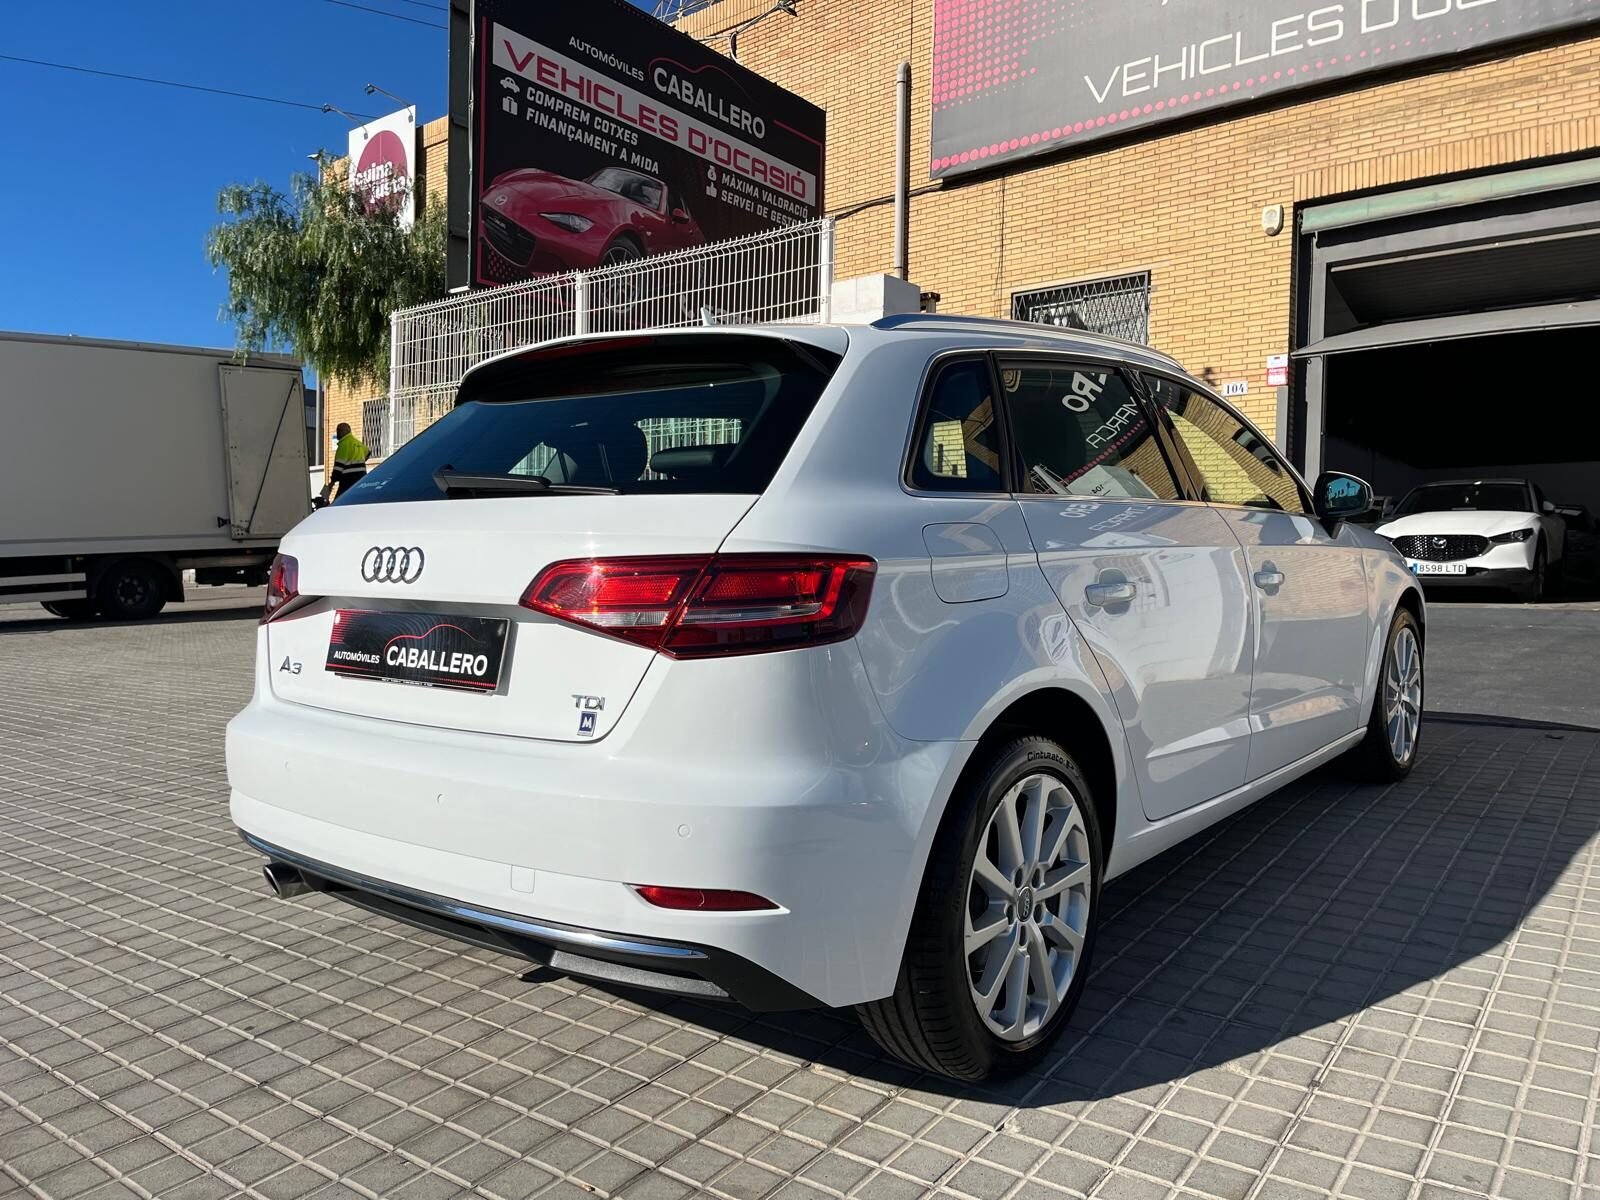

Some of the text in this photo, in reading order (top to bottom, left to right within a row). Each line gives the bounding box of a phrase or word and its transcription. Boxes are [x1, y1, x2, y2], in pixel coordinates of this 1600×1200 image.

[1084, 4, 1344, 104] VEHICLES
[569, 36, 766, 139] AUTOMÓVILES CABALLERO
[503, 39, 806, 199] VEHICLES D'OCASIÓ
[526, 86, 639, 146] COMPREM COTXES
[526, 107, 659, 175] FINANÇAMENT A MIDA
[721, 173, 809, 219] MÀXIMA VALORACIÓ
[721, 190, 754, 213] SERVEI
[756, 204, 768, 219] DE
[1226, 383, 1244, 395] 104
[1419, 564, 1465, 573] 8598 LTD
[279, 655, 302, 675] A3
[333, 645, 488, 676] AUTOMÓVILES CABALLERO
[571, 694, 605, 711] TDI
